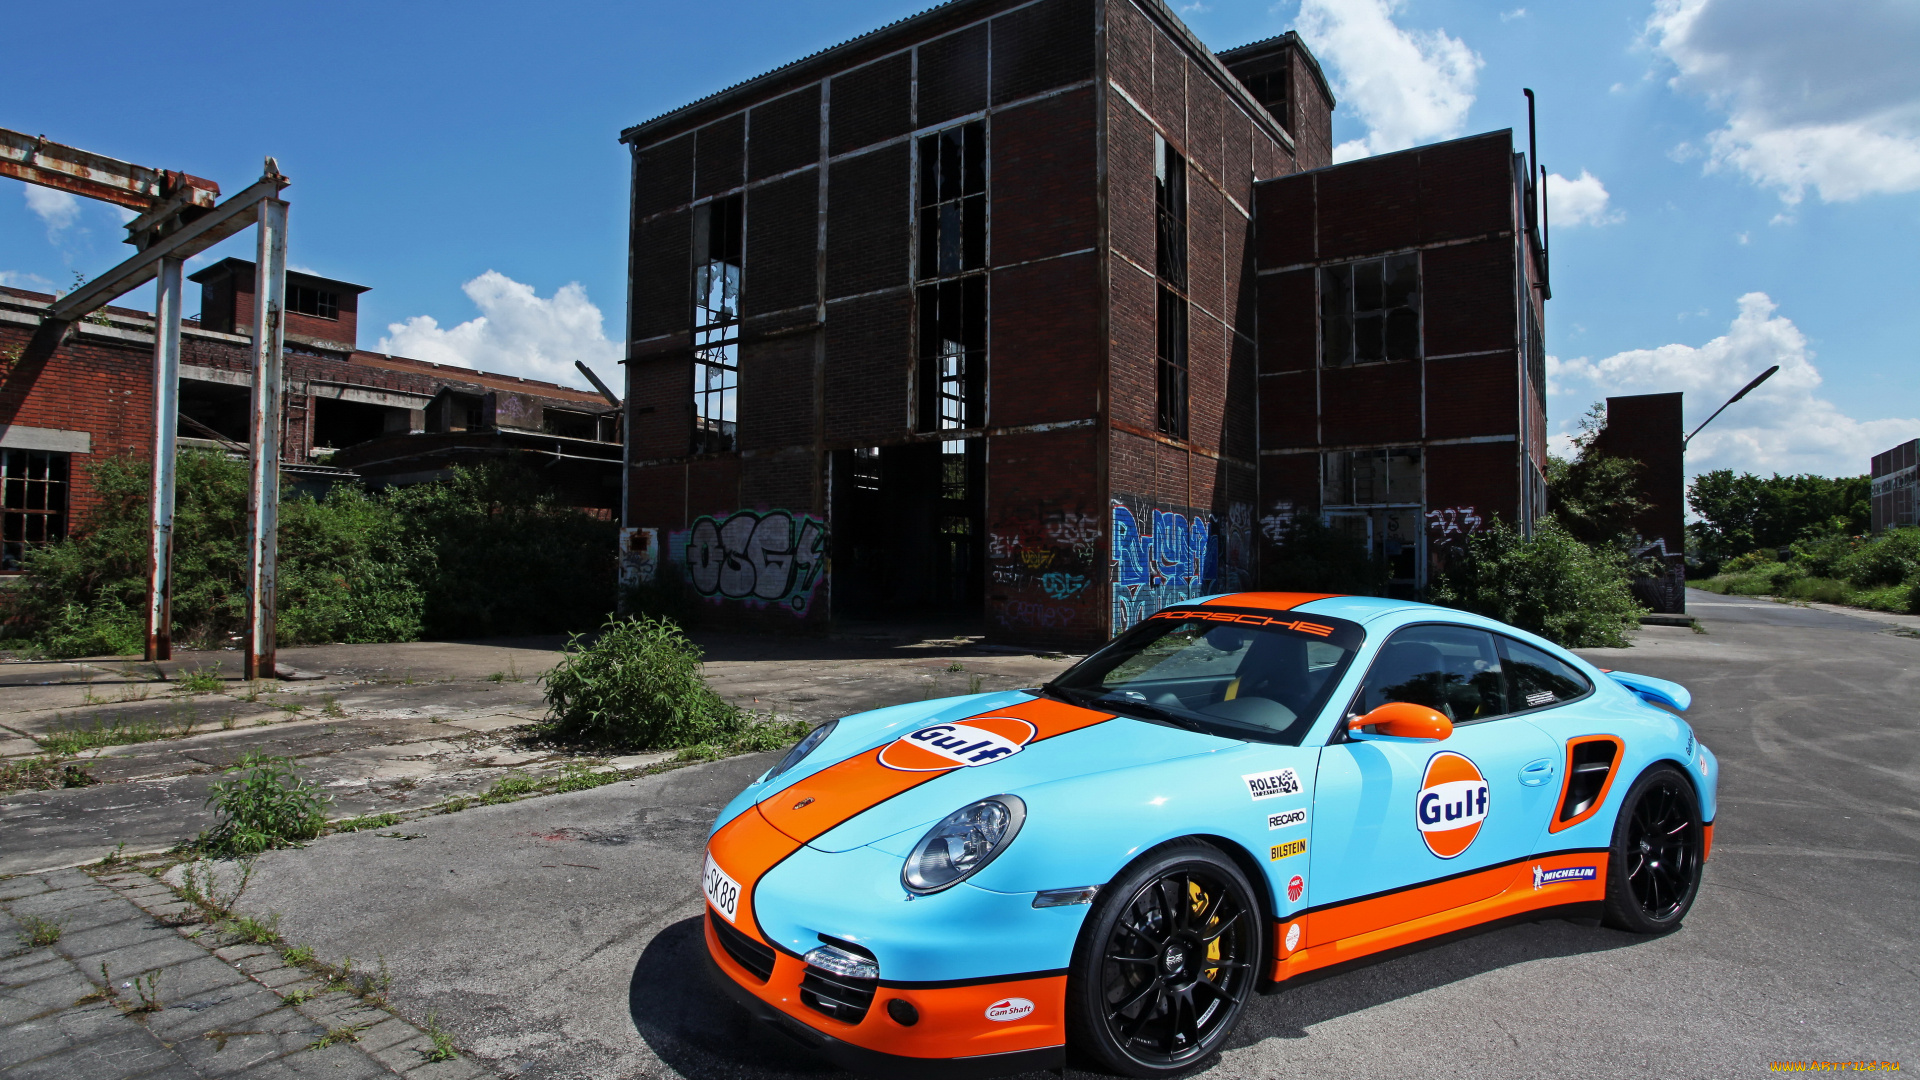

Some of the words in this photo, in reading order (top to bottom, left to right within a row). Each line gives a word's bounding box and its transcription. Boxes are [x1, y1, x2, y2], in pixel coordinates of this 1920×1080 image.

[1148, 611, 1335, 637] PORSCHE
[910, 725, 1012, 763] Gulf
[1248, 775, 1285, 792] ROLEX
[1284, 780, 1299, 794] 24
[1419, 786, 1487, 825] Gulf
[1269, 811, 1305, 827] RECARO
[1271, 840, 1306, 860] BILSTEIN
[1543, 868, 1595, 881] MICHELIN
[990, 1009, 1008, 1017] Cam
[1009, 1004, 1031, 1015] Shaft
